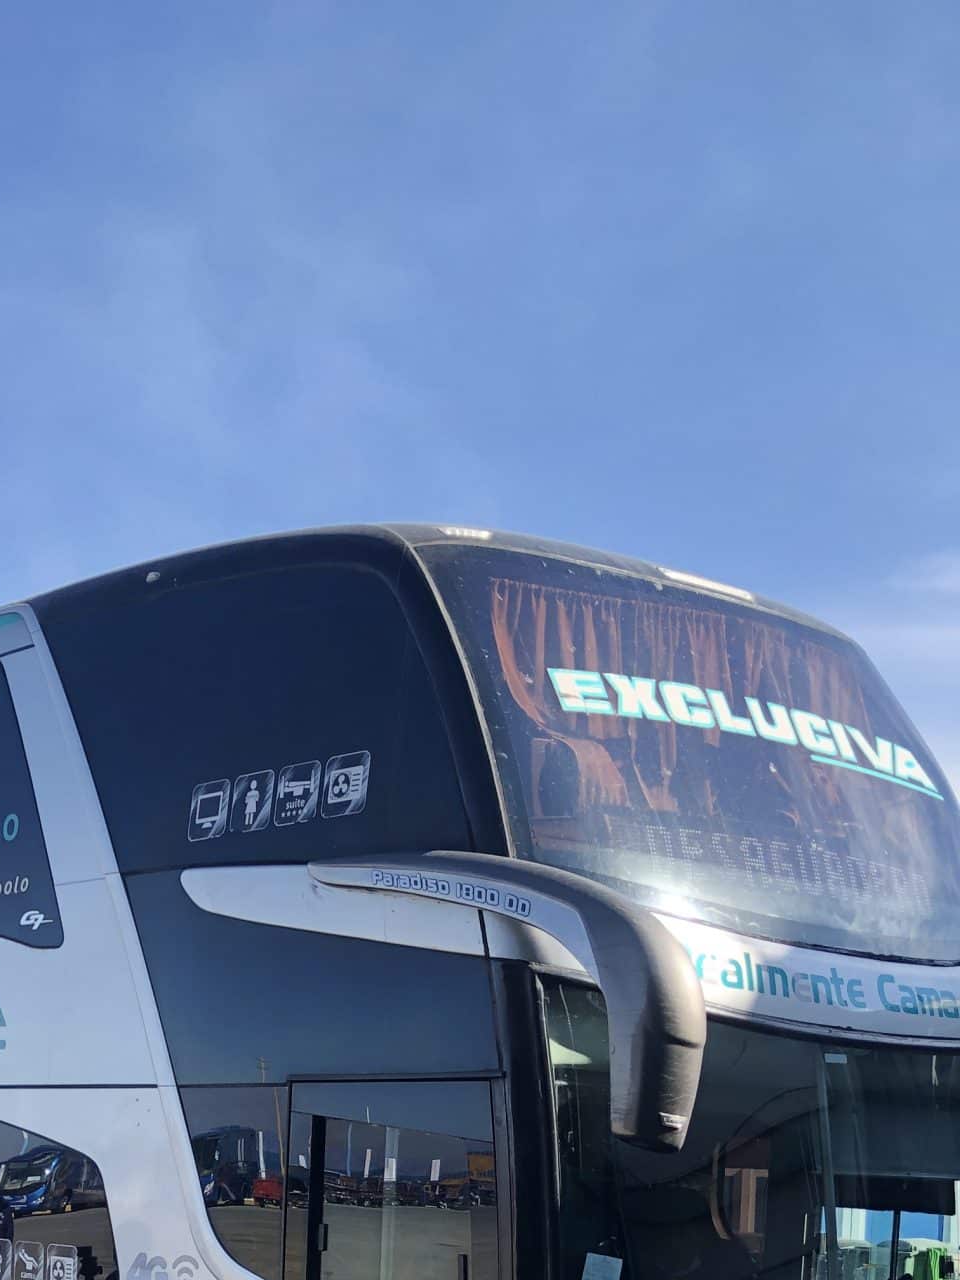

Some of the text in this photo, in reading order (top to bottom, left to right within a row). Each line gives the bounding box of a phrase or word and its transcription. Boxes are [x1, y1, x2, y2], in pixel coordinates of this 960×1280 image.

[547, 667, 939, 792] EXCLUCIVA
[285, 798, 305, 811] suite
[372, 869, 531, 918] Paradiso 1800 DD
